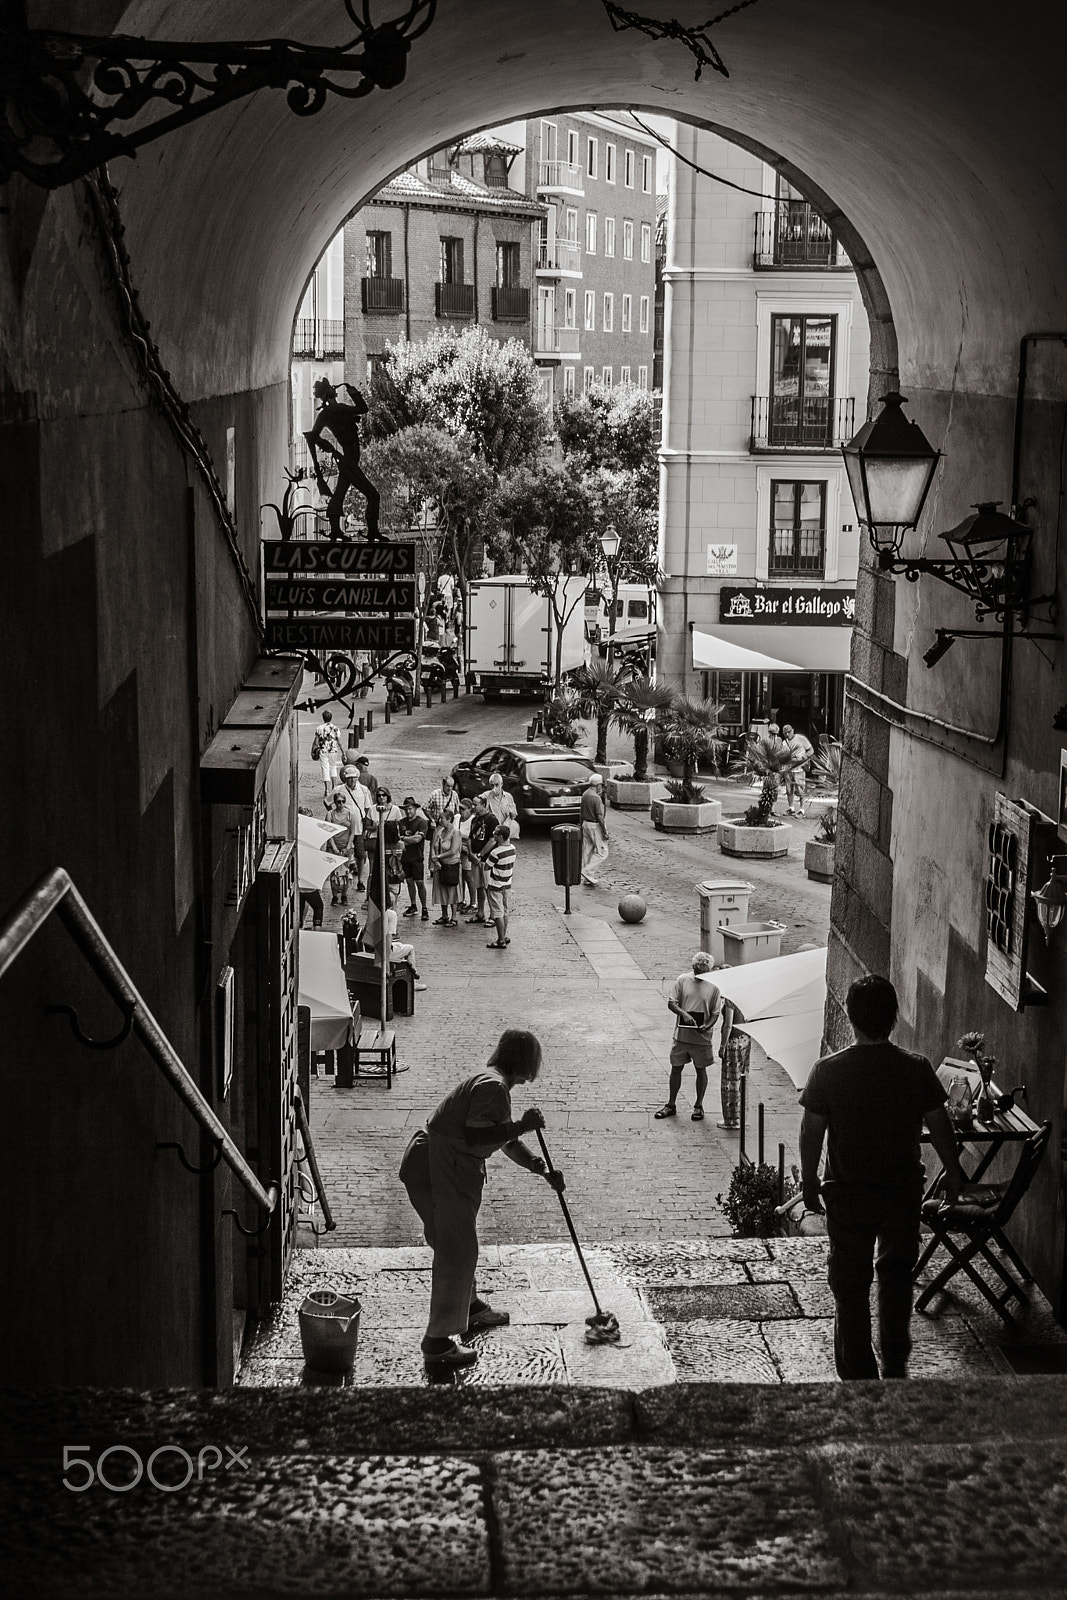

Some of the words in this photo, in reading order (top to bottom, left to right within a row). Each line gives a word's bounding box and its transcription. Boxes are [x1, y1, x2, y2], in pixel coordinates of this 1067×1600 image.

[754, 594, 779, 614] Bar
[782, 596, 793, 614] el
[795, 596, 841, 618] Gallego
